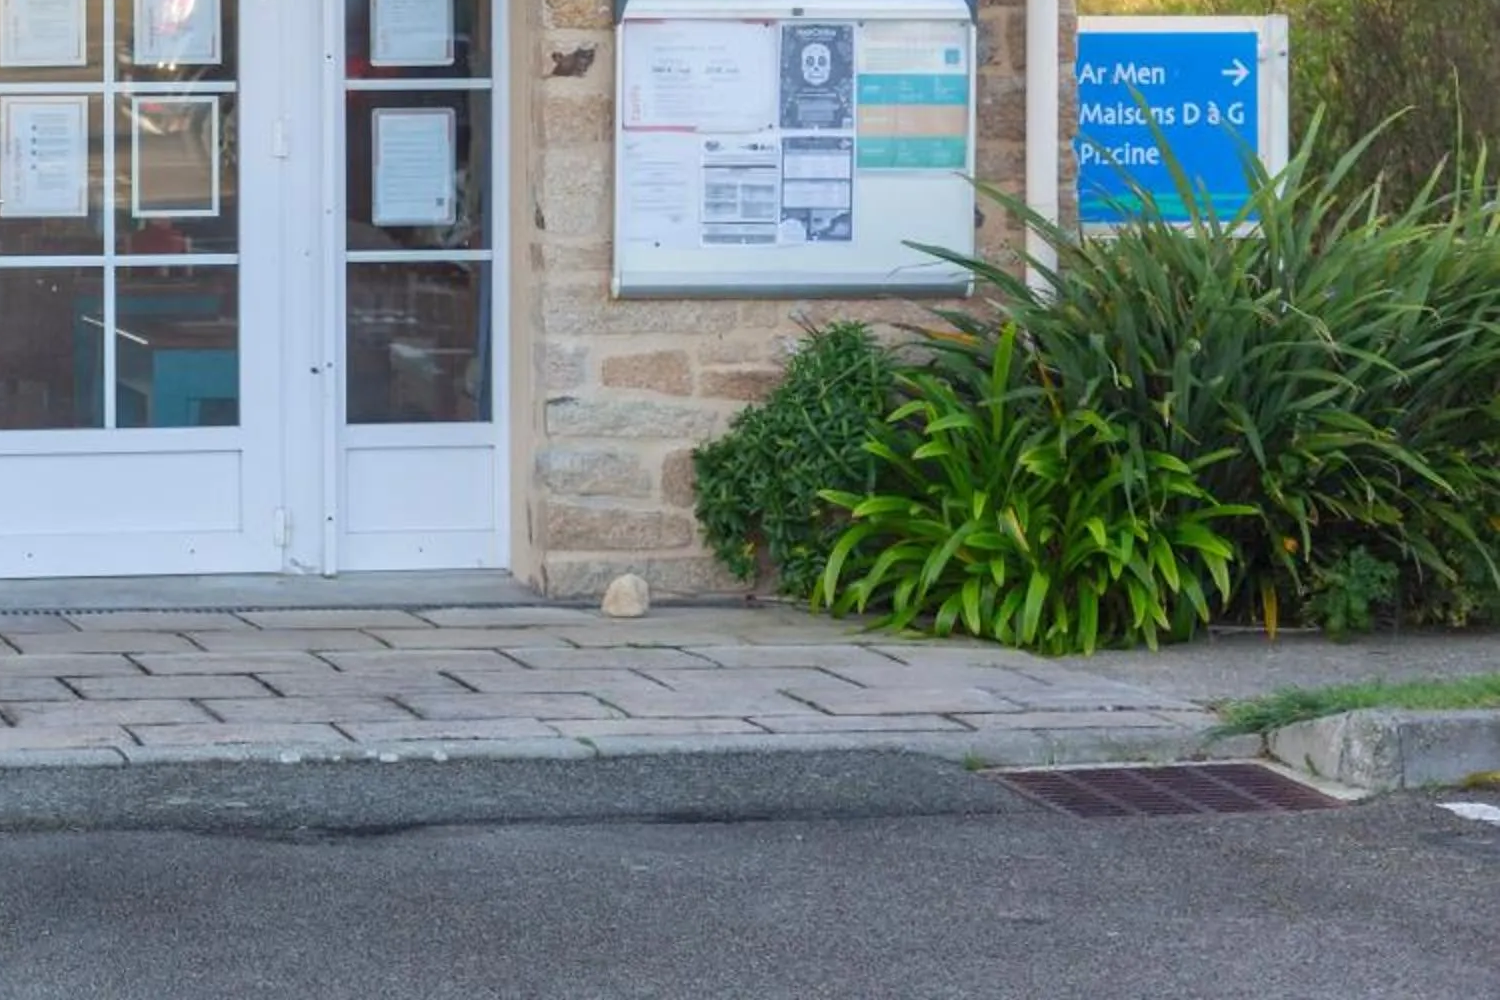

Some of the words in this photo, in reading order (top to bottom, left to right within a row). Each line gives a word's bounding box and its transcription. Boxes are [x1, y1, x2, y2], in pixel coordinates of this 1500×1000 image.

[1078, 61, 1107, 85] Ar
[1112, 61, 1166, 85] Men
[1182, 102, 1201, 125] D
[1206, 100, 1221, 125] à
[1227, 101, 1245, 125] G
